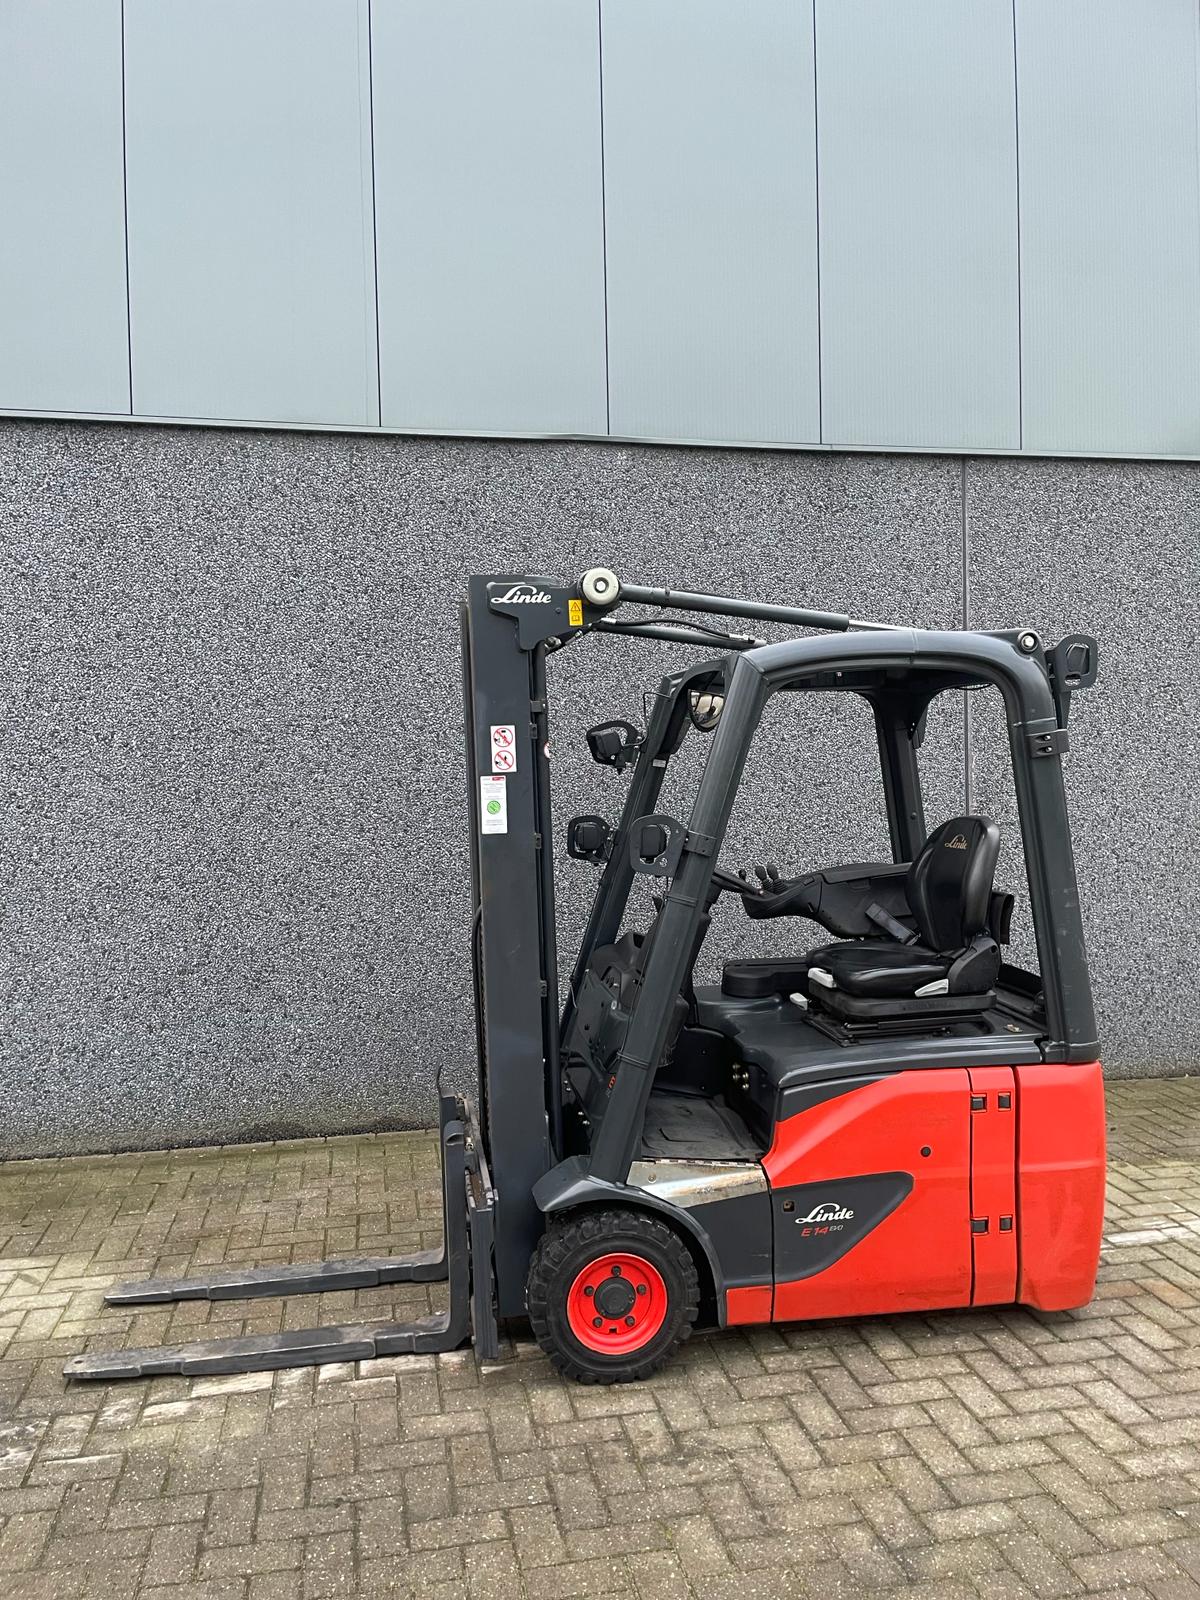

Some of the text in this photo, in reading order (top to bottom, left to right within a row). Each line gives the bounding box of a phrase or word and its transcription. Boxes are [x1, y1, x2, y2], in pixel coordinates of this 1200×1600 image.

[490, 585, 552, 604] Linde
[944, 834, 967, 850] Linde
[795, 1203, 855, 1224] Linde
